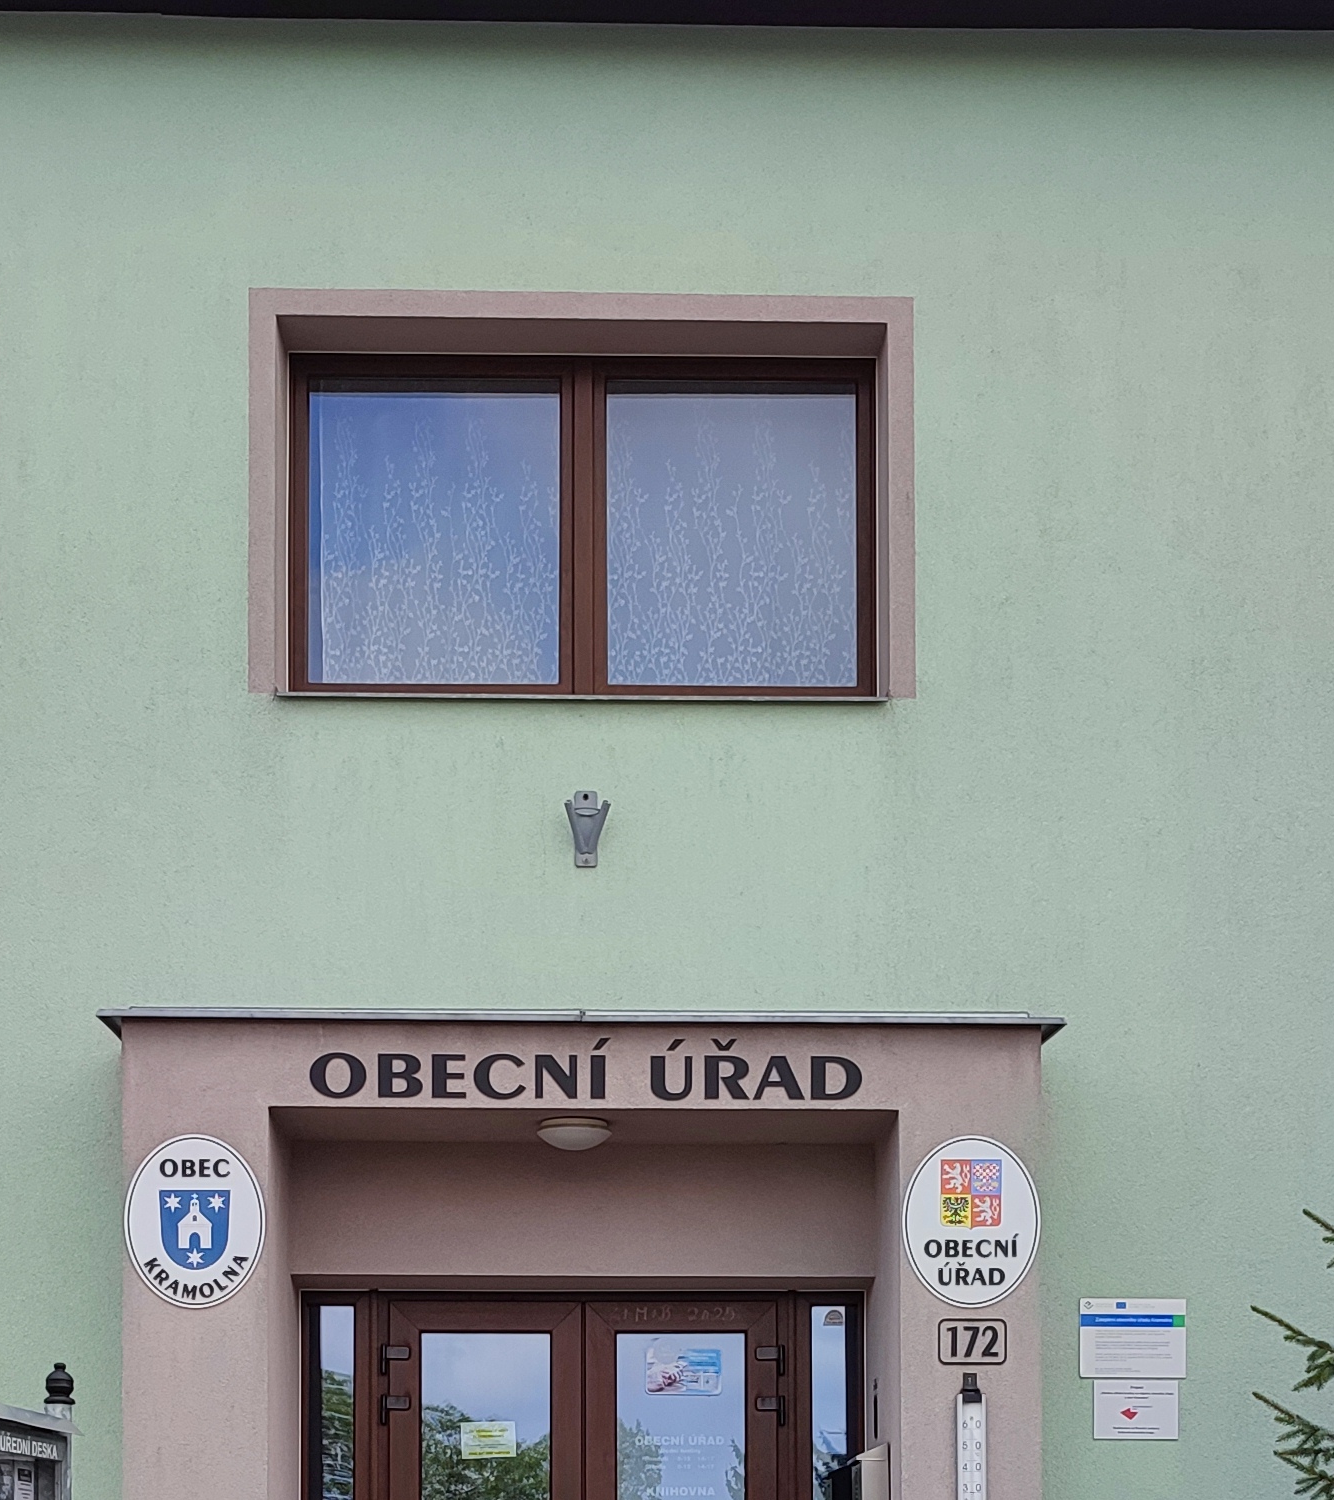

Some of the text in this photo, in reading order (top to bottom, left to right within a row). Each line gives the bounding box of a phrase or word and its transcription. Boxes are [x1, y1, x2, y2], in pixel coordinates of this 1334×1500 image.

[309, 1037, 863, 1101] OBECNÍ ÚŘAD
[159, 1158, 231, 1178] OBEC
[923, 1233, 1019, 1258] OBECNÍ
[144, 1255, 249, 1300] KRAMOLNA
[937, 1262, 1006, 1286] ÚŘAD
[946, 1325, 999, 1359] 172
[0, 1431, 58, 1460] ÚŘEDNÍ DESKA
[635, 1434, 725, 1446] OBECNÍ ÚŘAD
[647, 1486, 716, 1496] KNIHOVNA
